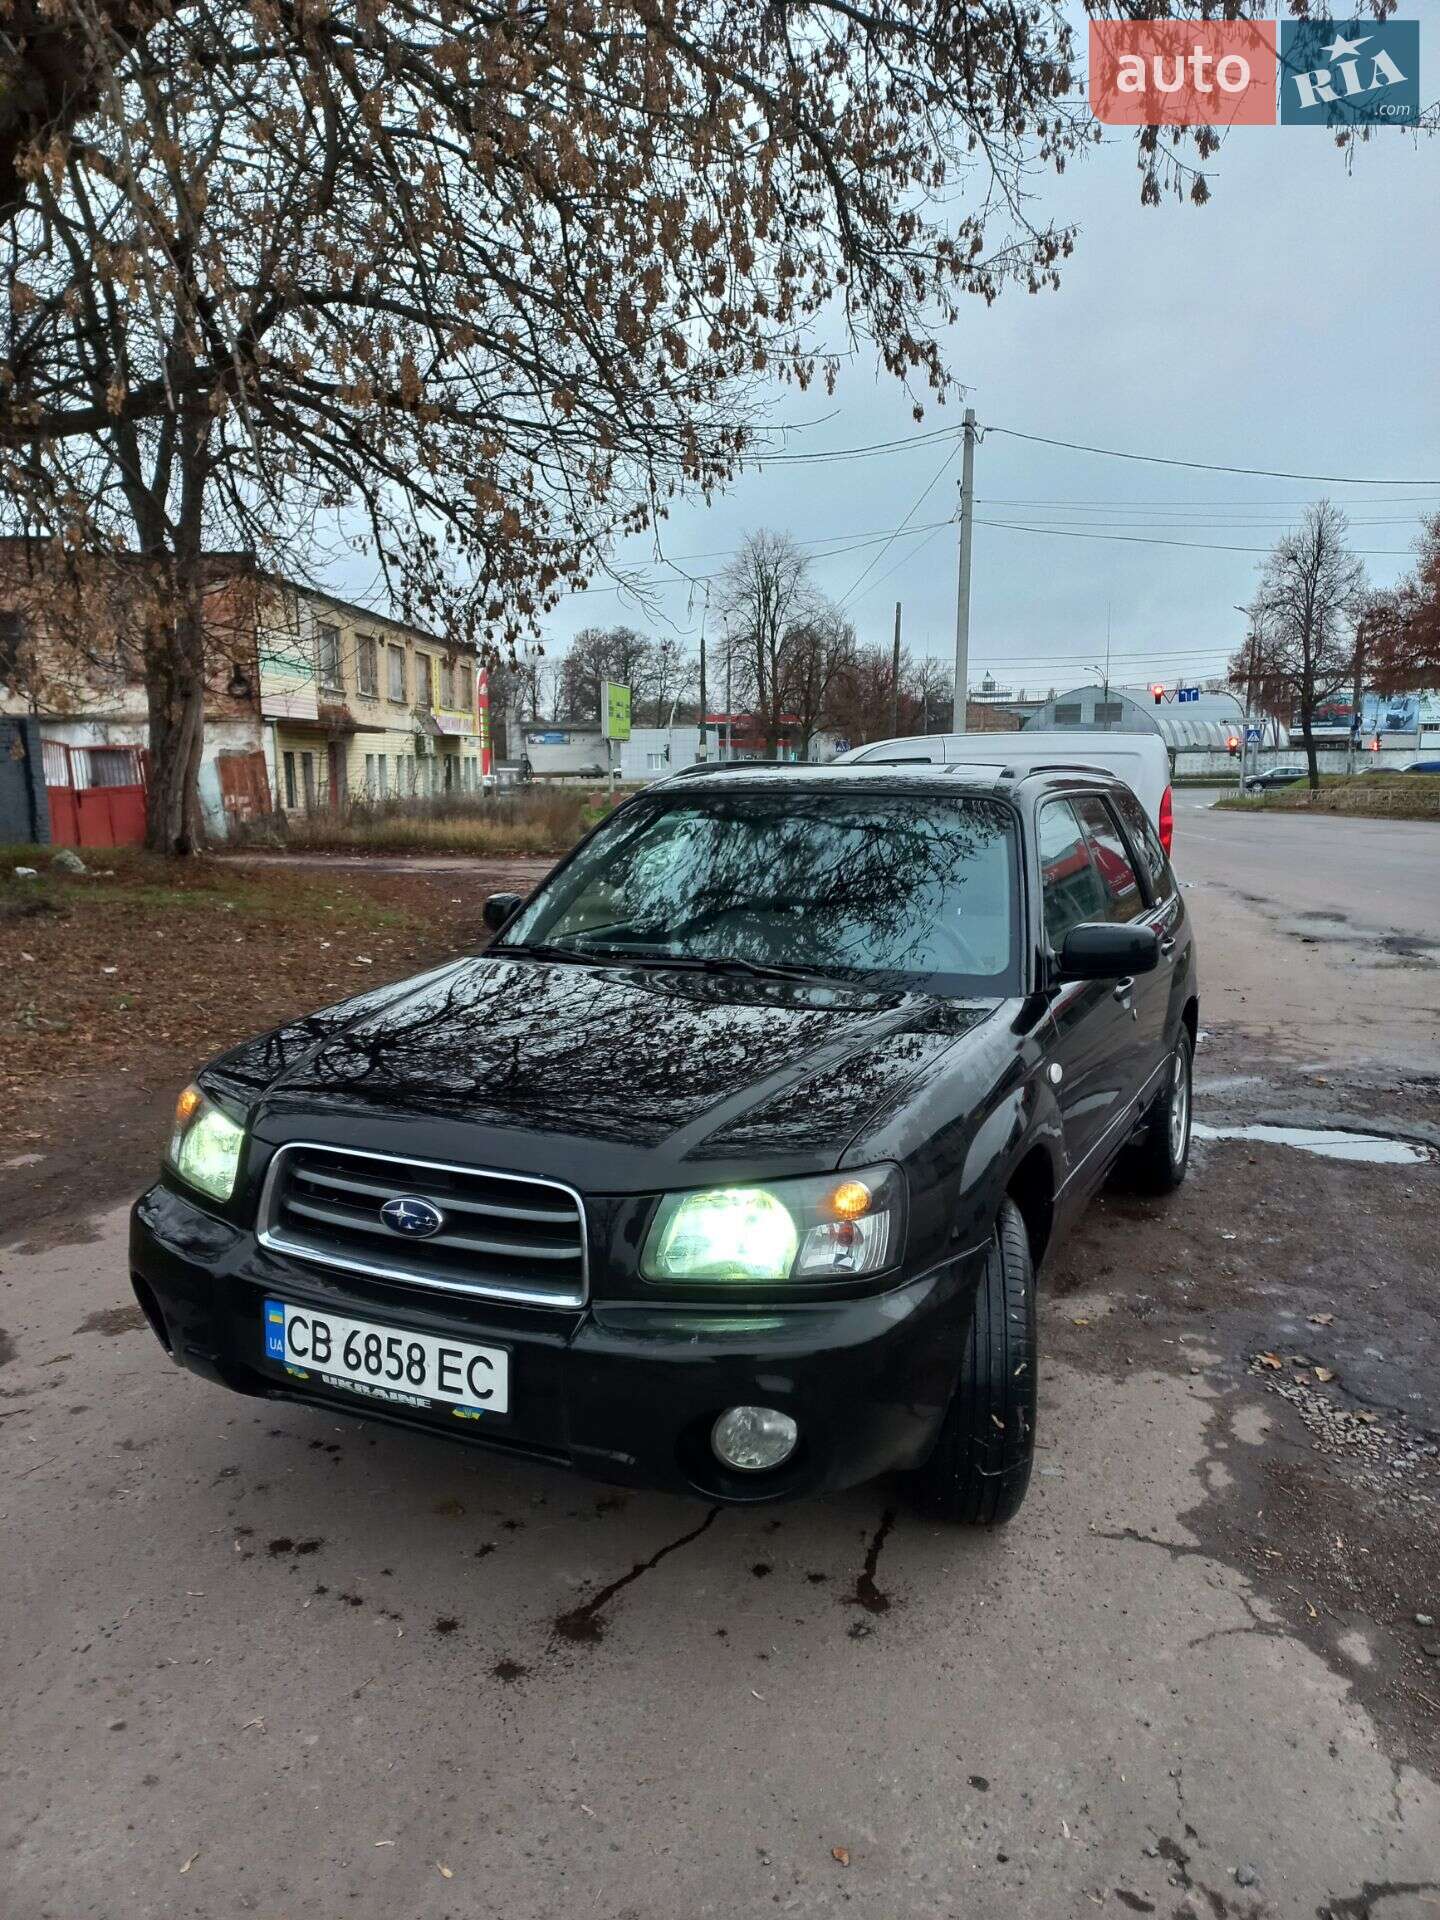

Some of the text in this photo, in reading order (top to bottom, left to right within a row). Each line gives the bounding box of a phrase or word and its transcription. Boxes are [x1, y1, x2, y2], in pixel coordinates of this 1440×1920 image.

[269, 1337, 284, 1353] UA
[287, 1315, 495, 1400] CB 6858 EC
